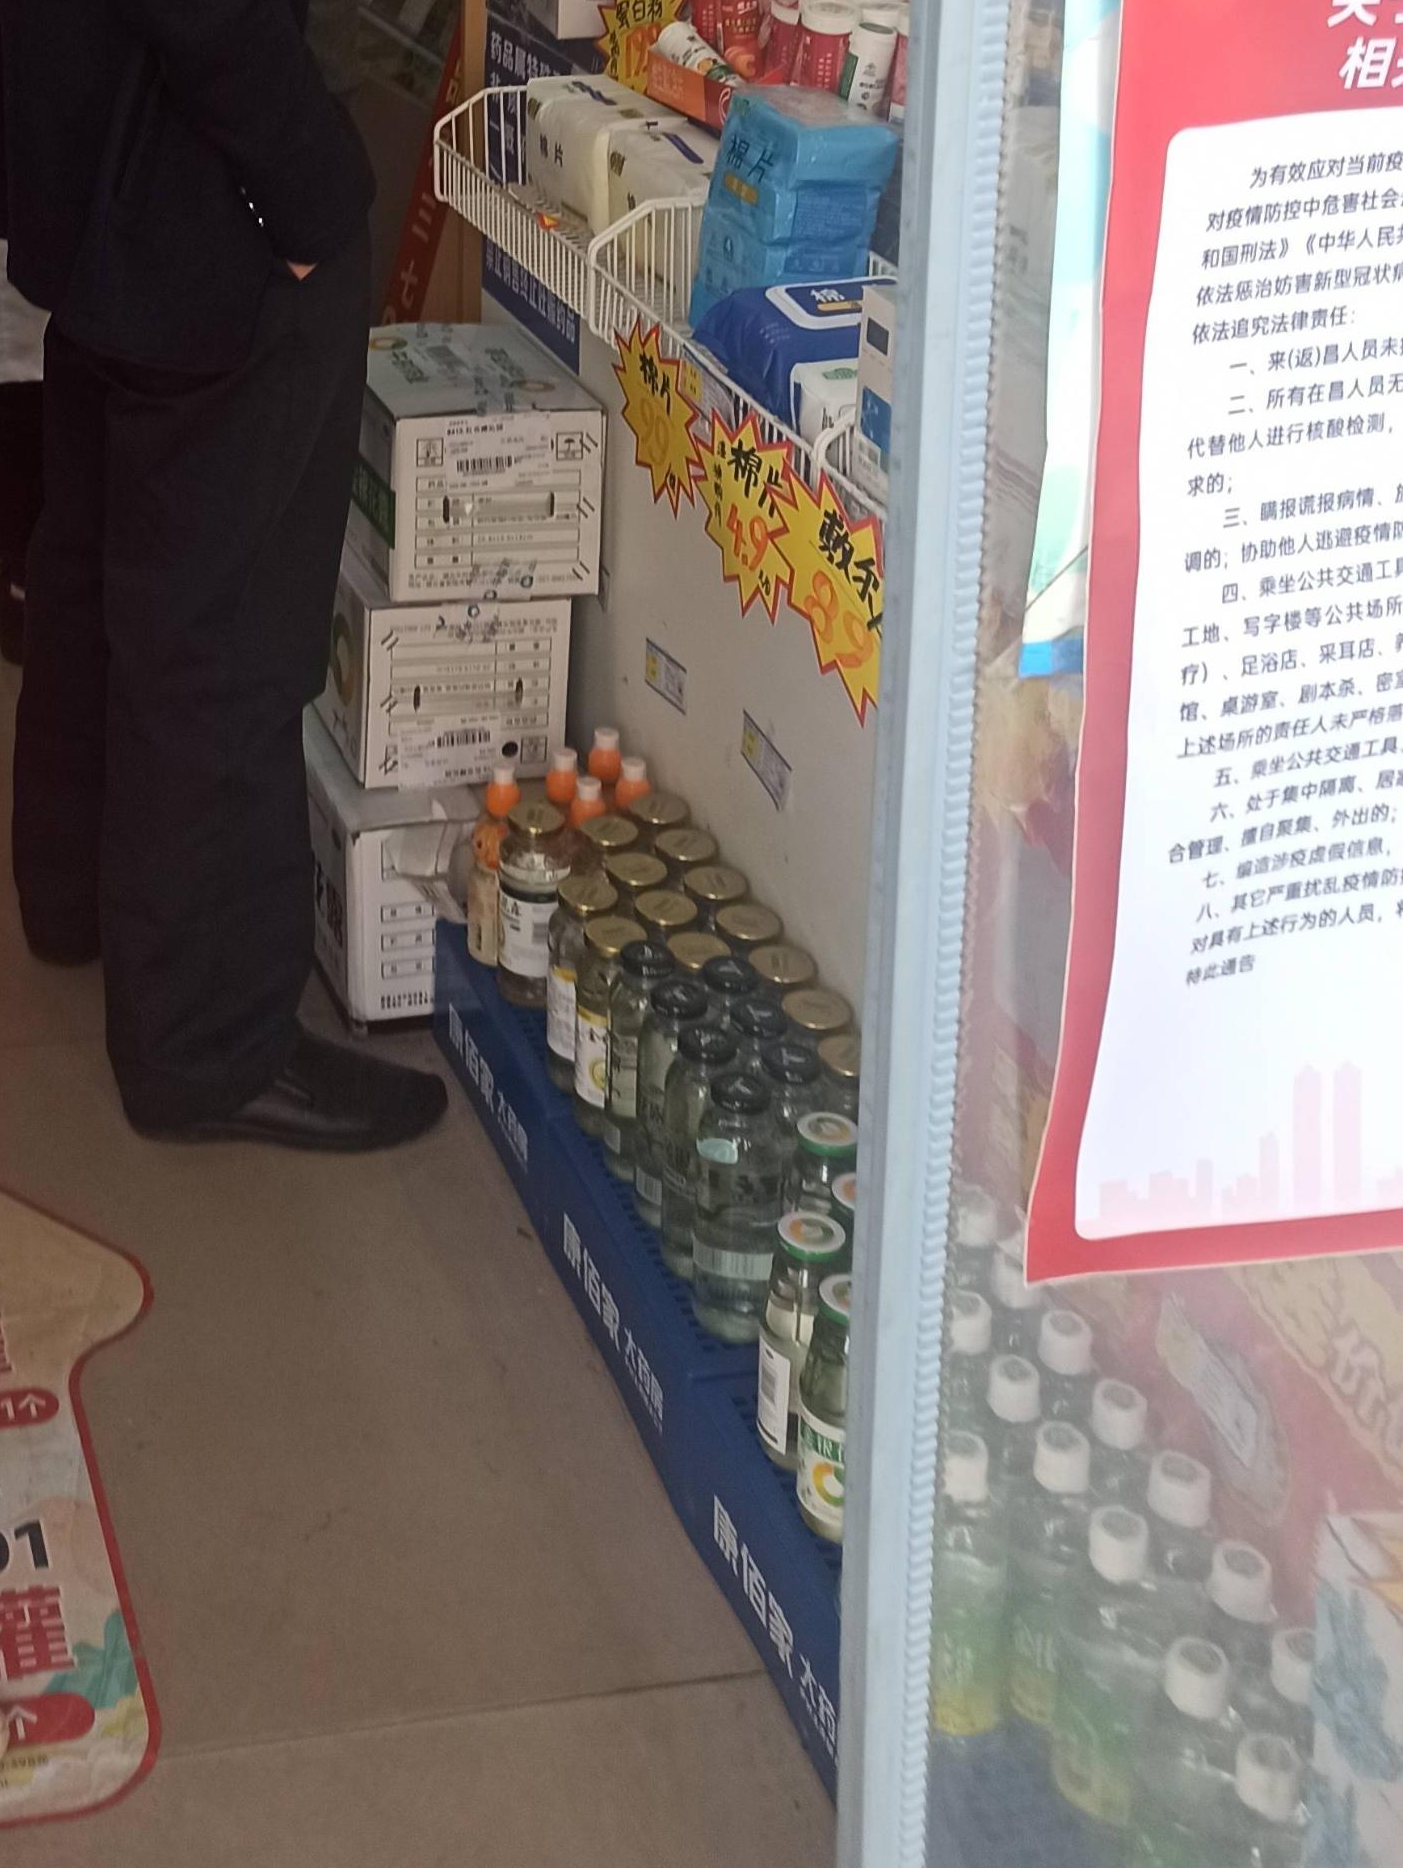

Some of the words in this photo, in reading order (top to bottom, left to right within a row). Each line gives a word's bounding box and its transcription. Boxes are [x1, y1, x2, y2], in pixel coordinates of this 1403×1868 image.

[489, 31, 562, 80] 药品属特殊
[1339, 35, 1403, 91] 相
[726, 133, 778, 183] 棉片
[1205, 186, 1403, 233] 对疫情防控中危害社会
[1229, 336, 1403, 376] 一、来(返)昌人员未
[727, 438, 783, 519] 棉片
[1185, 953, 1256, 987] 特此通告
[449, 1002, 495, 1116] 康佰家
[563, 1211, 622, 1352] 康佰家
[622, 1324, 665, 1418] 大药房
[713, 1494, 796, 1680] 康佰家
